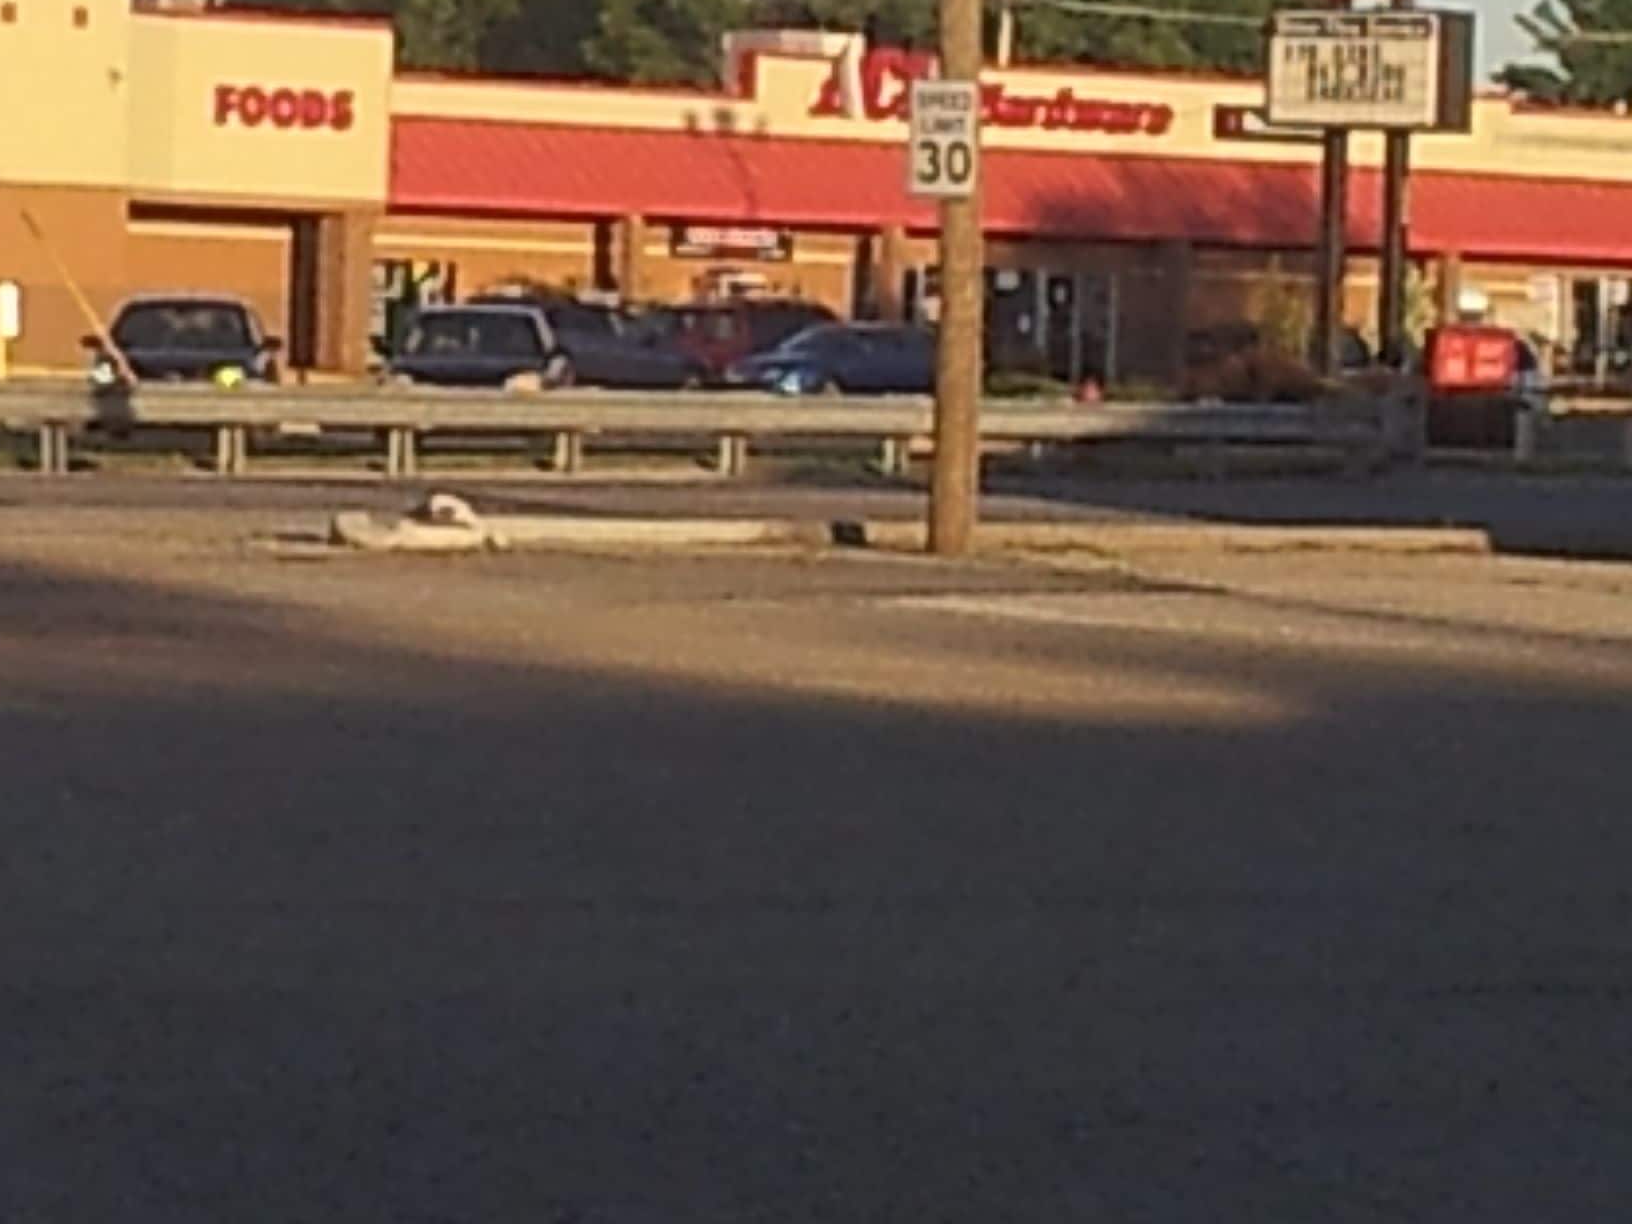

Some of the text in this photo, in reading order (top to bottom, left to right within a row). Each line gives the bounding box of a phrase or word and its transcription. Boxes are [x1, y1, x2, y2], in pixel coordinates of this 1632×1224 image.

[806, 44, 942, 122] AC
[918, 89, 972, 111] SPEED
[213, 85, 355, 131] FOODS
[919, 117, 966, 135] LIMIT
[917, 140, 972, 184] 30
